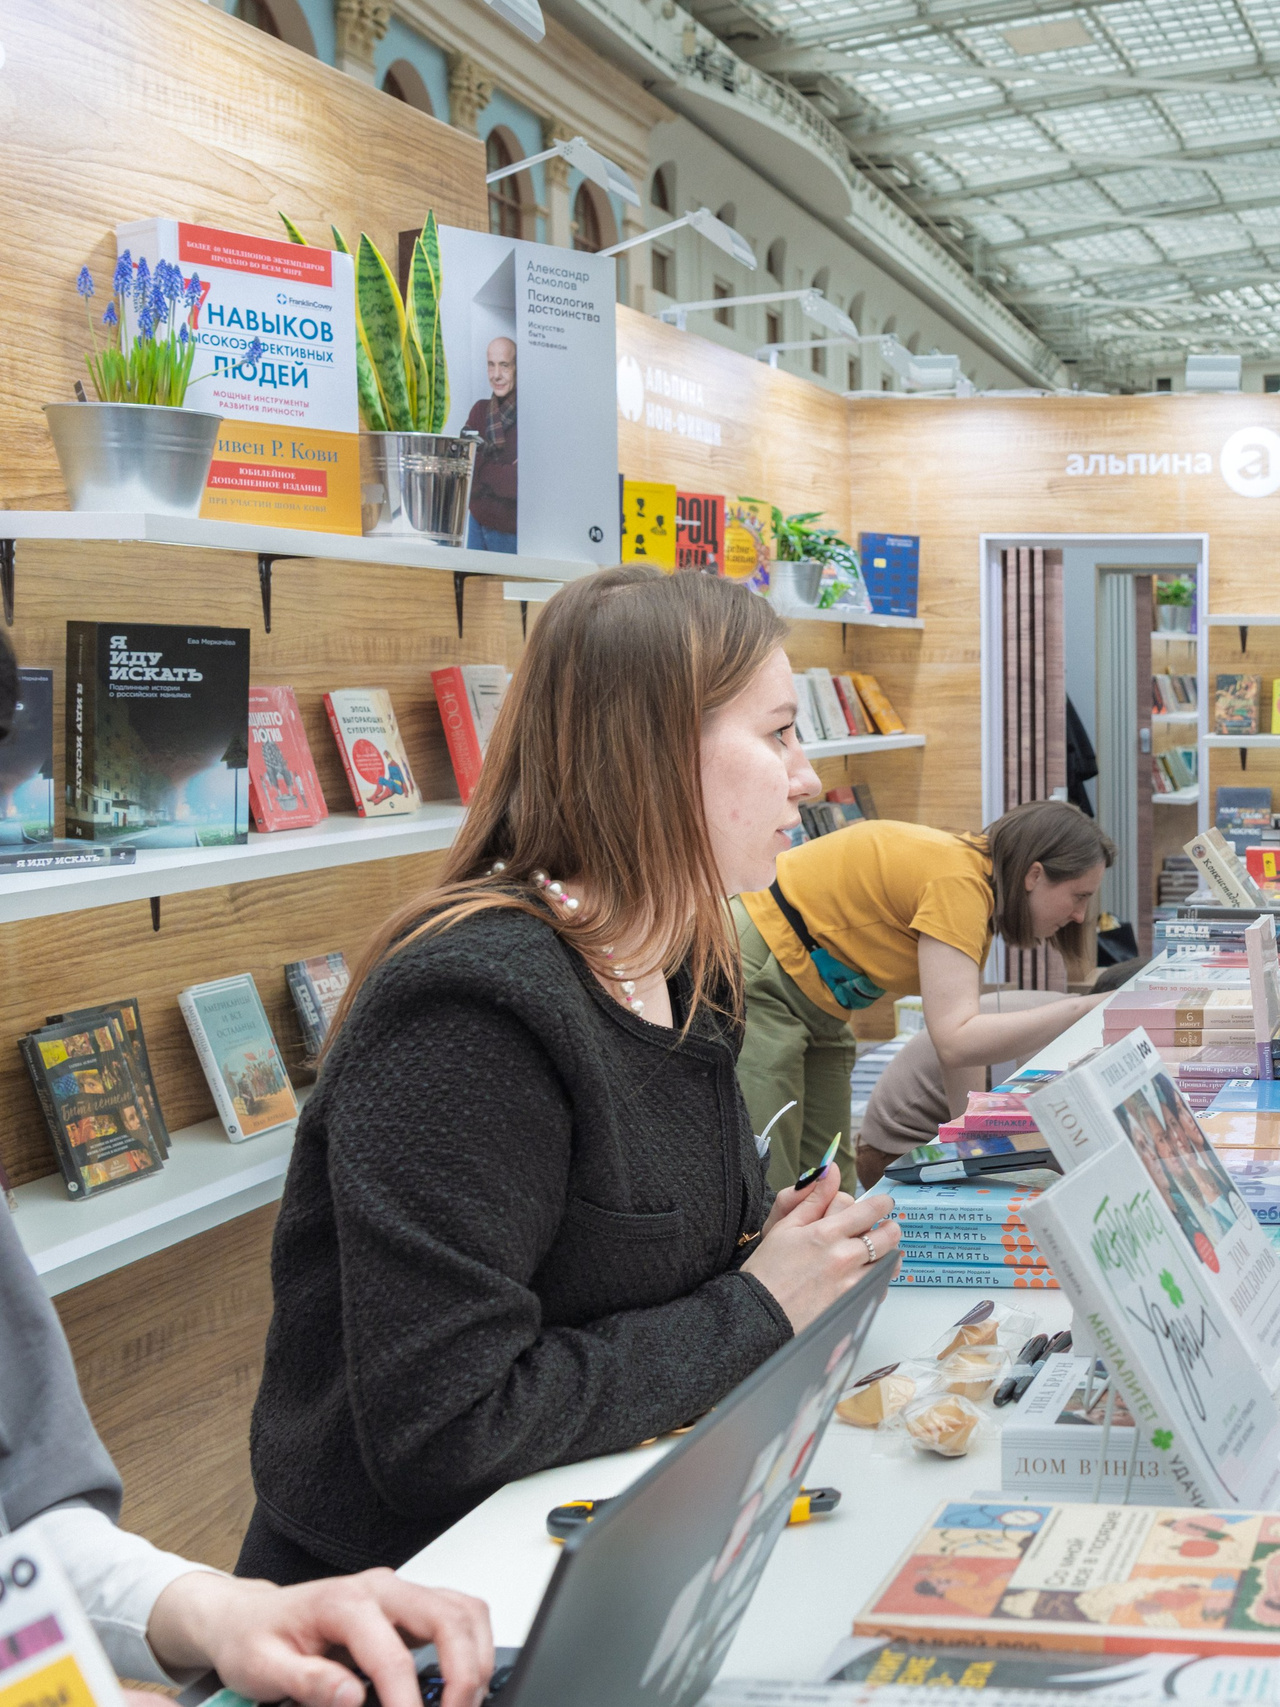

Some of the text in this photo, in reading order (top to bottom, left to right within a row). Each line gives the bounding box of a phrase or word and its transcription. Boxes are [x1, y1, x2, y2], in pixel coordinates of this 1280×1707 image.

[211, 254, 248, 267] ПРОДАНО
[222, 247, 272, 263] МИЛЛИОНОВ
[272, 256, 325, 272] ЭКЗЕМПЛЯРОВ
[526, 260, 590, 284] Александр
[527, 272, 577, 291] Асмолов
[528, 288, 595, 311] Психология
[527, 303, 601, 323] достоинства
[207, 303, 334, 343] НАВЫКОВ
[190, 332, 334, 363] ЫСОКОЭФЕКТИВНЫХ
[211, 355, 309, 389] ЛЮДЕЙ
[213, 389, 310, 409] МОЩНЫЕ ИНСТРУМЕНТЫ
[219, 401, 305, 417] РАЗВИТИЯ ЛИЧНОСТИ
[218, 439, 339, 463] ивен Р. Кови
[1065, 451, 1213, 476] альпина
[239, 466, 297, 480] ЮБИЛЕЙНОЕ
[211, 476, 323, 493] ДОПОЛНЕННОЕ ИЗДАНИЕ
[110, 635, 128, 650] Я
[109, 651, 163, 668] ИДУ
[109, 666, 204, 682] ИСКАТЬ
[109, 683, 181, 692] Подлинные истории
[16, 854, 101, 868] Я ИДУ ИСКАТЬ
[1165, 925, 1210, 935] ГРАД
[1186, 1012, 1194, 1021] 6
[985, 1119, 1027, 1127] ТРЕНАЖЕР
[1051, 1099, 1089, 1148] ДОМ
[883, 1212, 993, 1222] ОРОШАЯ ПАМЯТЬ
[935, 1232, 987, 1241] ПАМЯТЬ
[937, 1252, 990, 1261] ПАМЯТЬ
[891, 1275, 1000, 1285] ОРОШАЯ ПАМЯТЬ
[1086, 1311, 1159, 1424] МЕНТАЛИТЕТ
[1015, 1457, 1067, 1477] ДОМ
